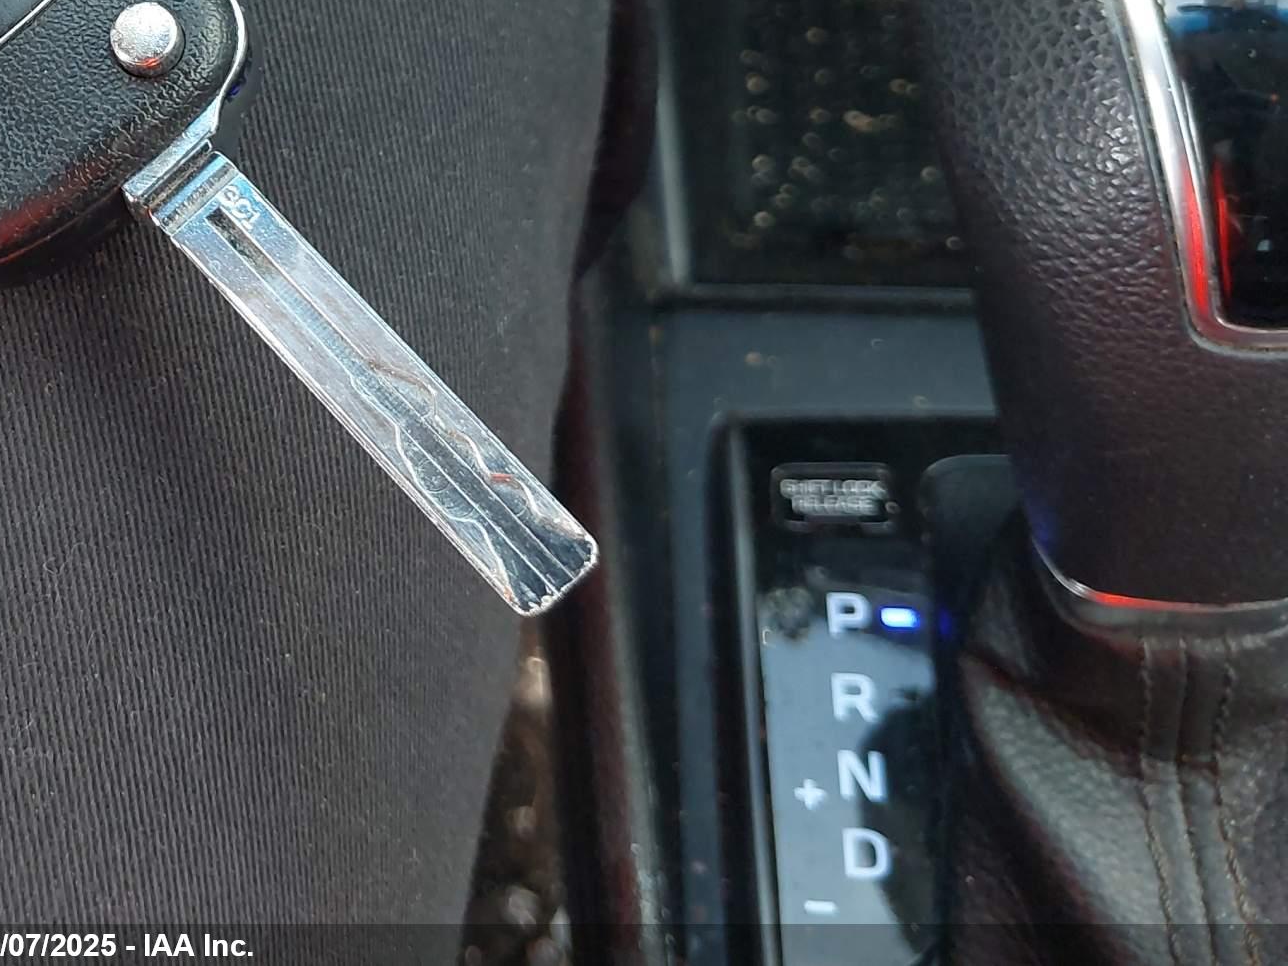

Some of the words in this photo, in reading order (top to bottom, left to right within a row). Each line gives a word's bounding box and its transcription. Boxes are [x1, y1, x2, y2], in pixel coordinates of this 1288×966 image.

[825, 592, 872, 639] P
[831, 672, 879, 722] R
[837, 749, 888, 803] N
[842, 827, 892, 880] D
